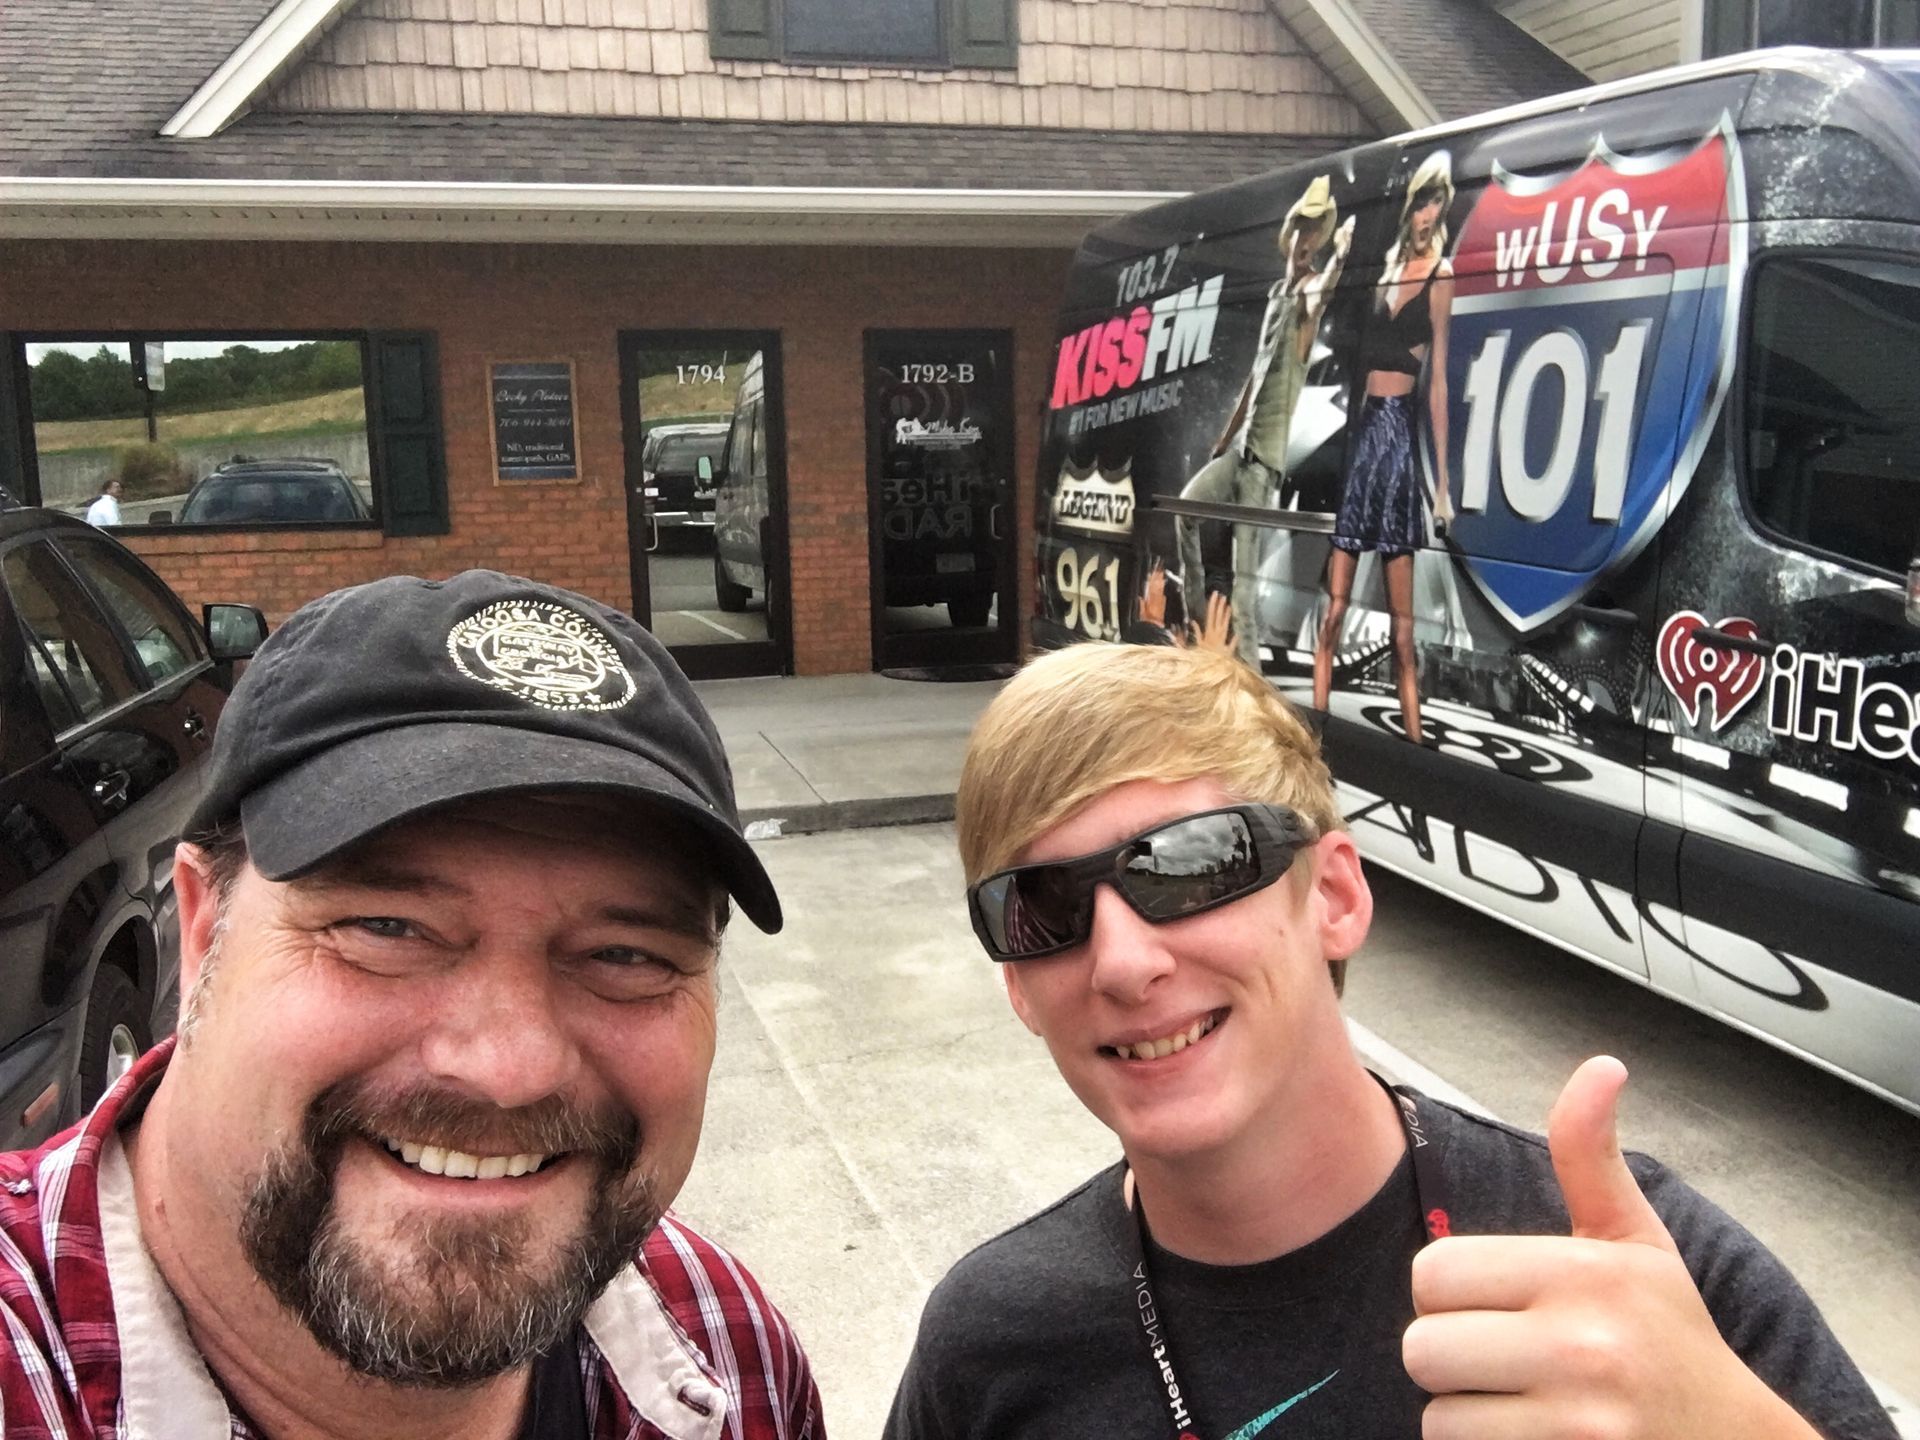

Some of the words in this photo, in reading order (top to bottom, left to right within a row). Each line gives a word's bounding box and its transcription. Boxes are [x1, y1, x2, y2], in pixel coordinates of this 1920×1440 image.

[1116, 243, 1180, 307] 103.7
[675, 364, 726, 385] 1794
[901, 363, 975, 384] 1792-B
[1085, 402, 1109, 431] FOR
[1109, 392, 1139, 427] NEW
[1139, 379, 1184, 416] MUSIC
[1462, 317, 1653, 524] 101
[1059, 490, 1131, 525] LEGEND
[457, 608, 542, 648] CATOOSA
[549, 612, 620, 674] COUNTY
[520, 686, 580, 704] 1853
[1767, 643, 1920, 768] iHe
[1344, 799, 1830, 1012] ADIO
[1403, 1110, 1429, 1148] DIA
